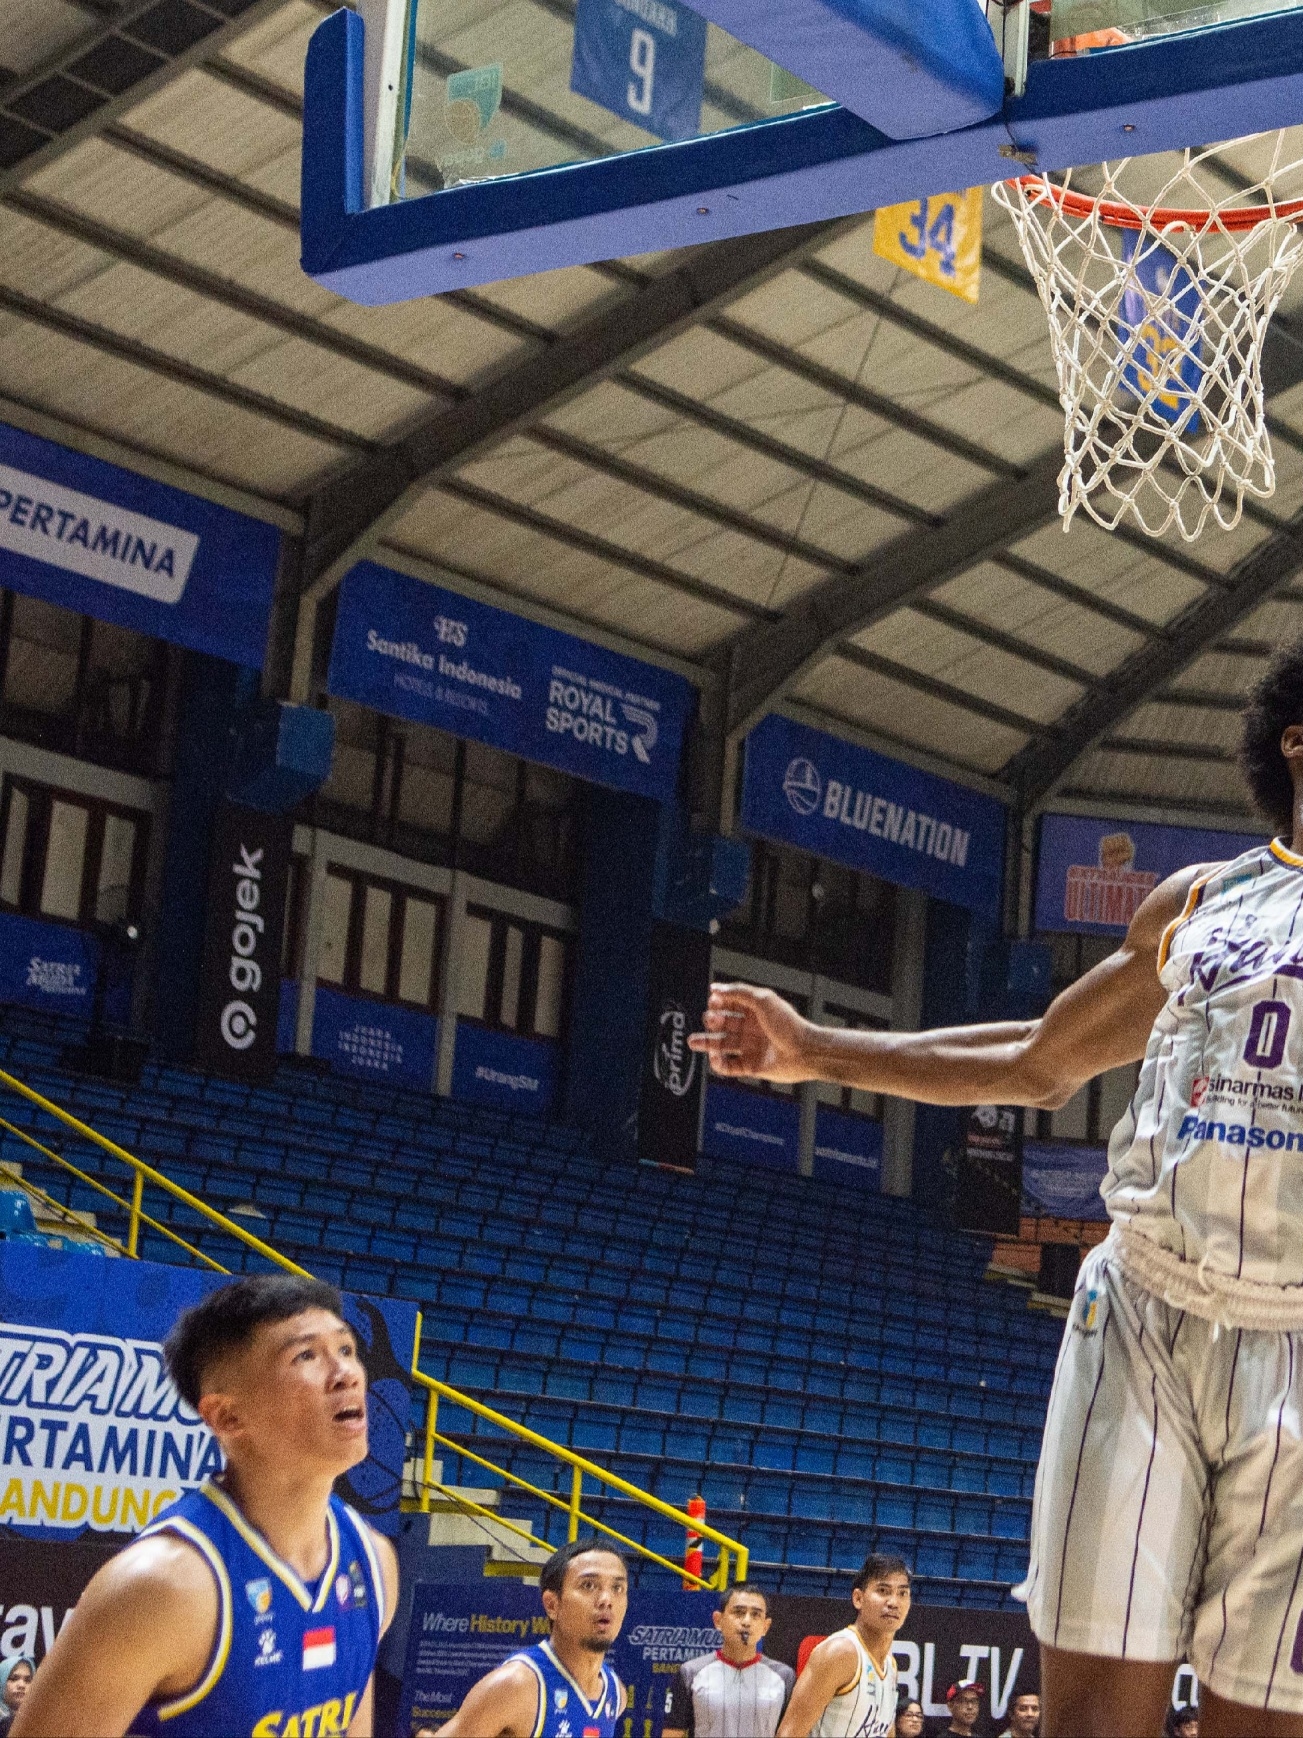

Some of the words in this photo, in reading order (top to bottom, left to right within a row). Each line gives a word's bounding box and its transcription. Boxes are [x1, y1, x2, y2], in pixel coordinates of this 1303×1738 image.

[627, 28, 655, 115] 9
[367, 629, 435, 671] Santika
[438, 654, 522, 700] Indonesia
[546, 707, 629, 755] SPORTS
[549, 680, 617, 725] ROYAL
[824, 779, 971, 868] BLUENATION
[229, 842, 265, 993] gojek
[1243, 1001, 1291, 1069] 0
[1208, 1073, 1294, 1101] sinarmas
[0, 1415, 224, 1481] RTAMINA
[422, 1612, 469, 1632] Where
[470, 1614, 530, 1638] History
[891, 1640, 1024, 1720] BLTV
